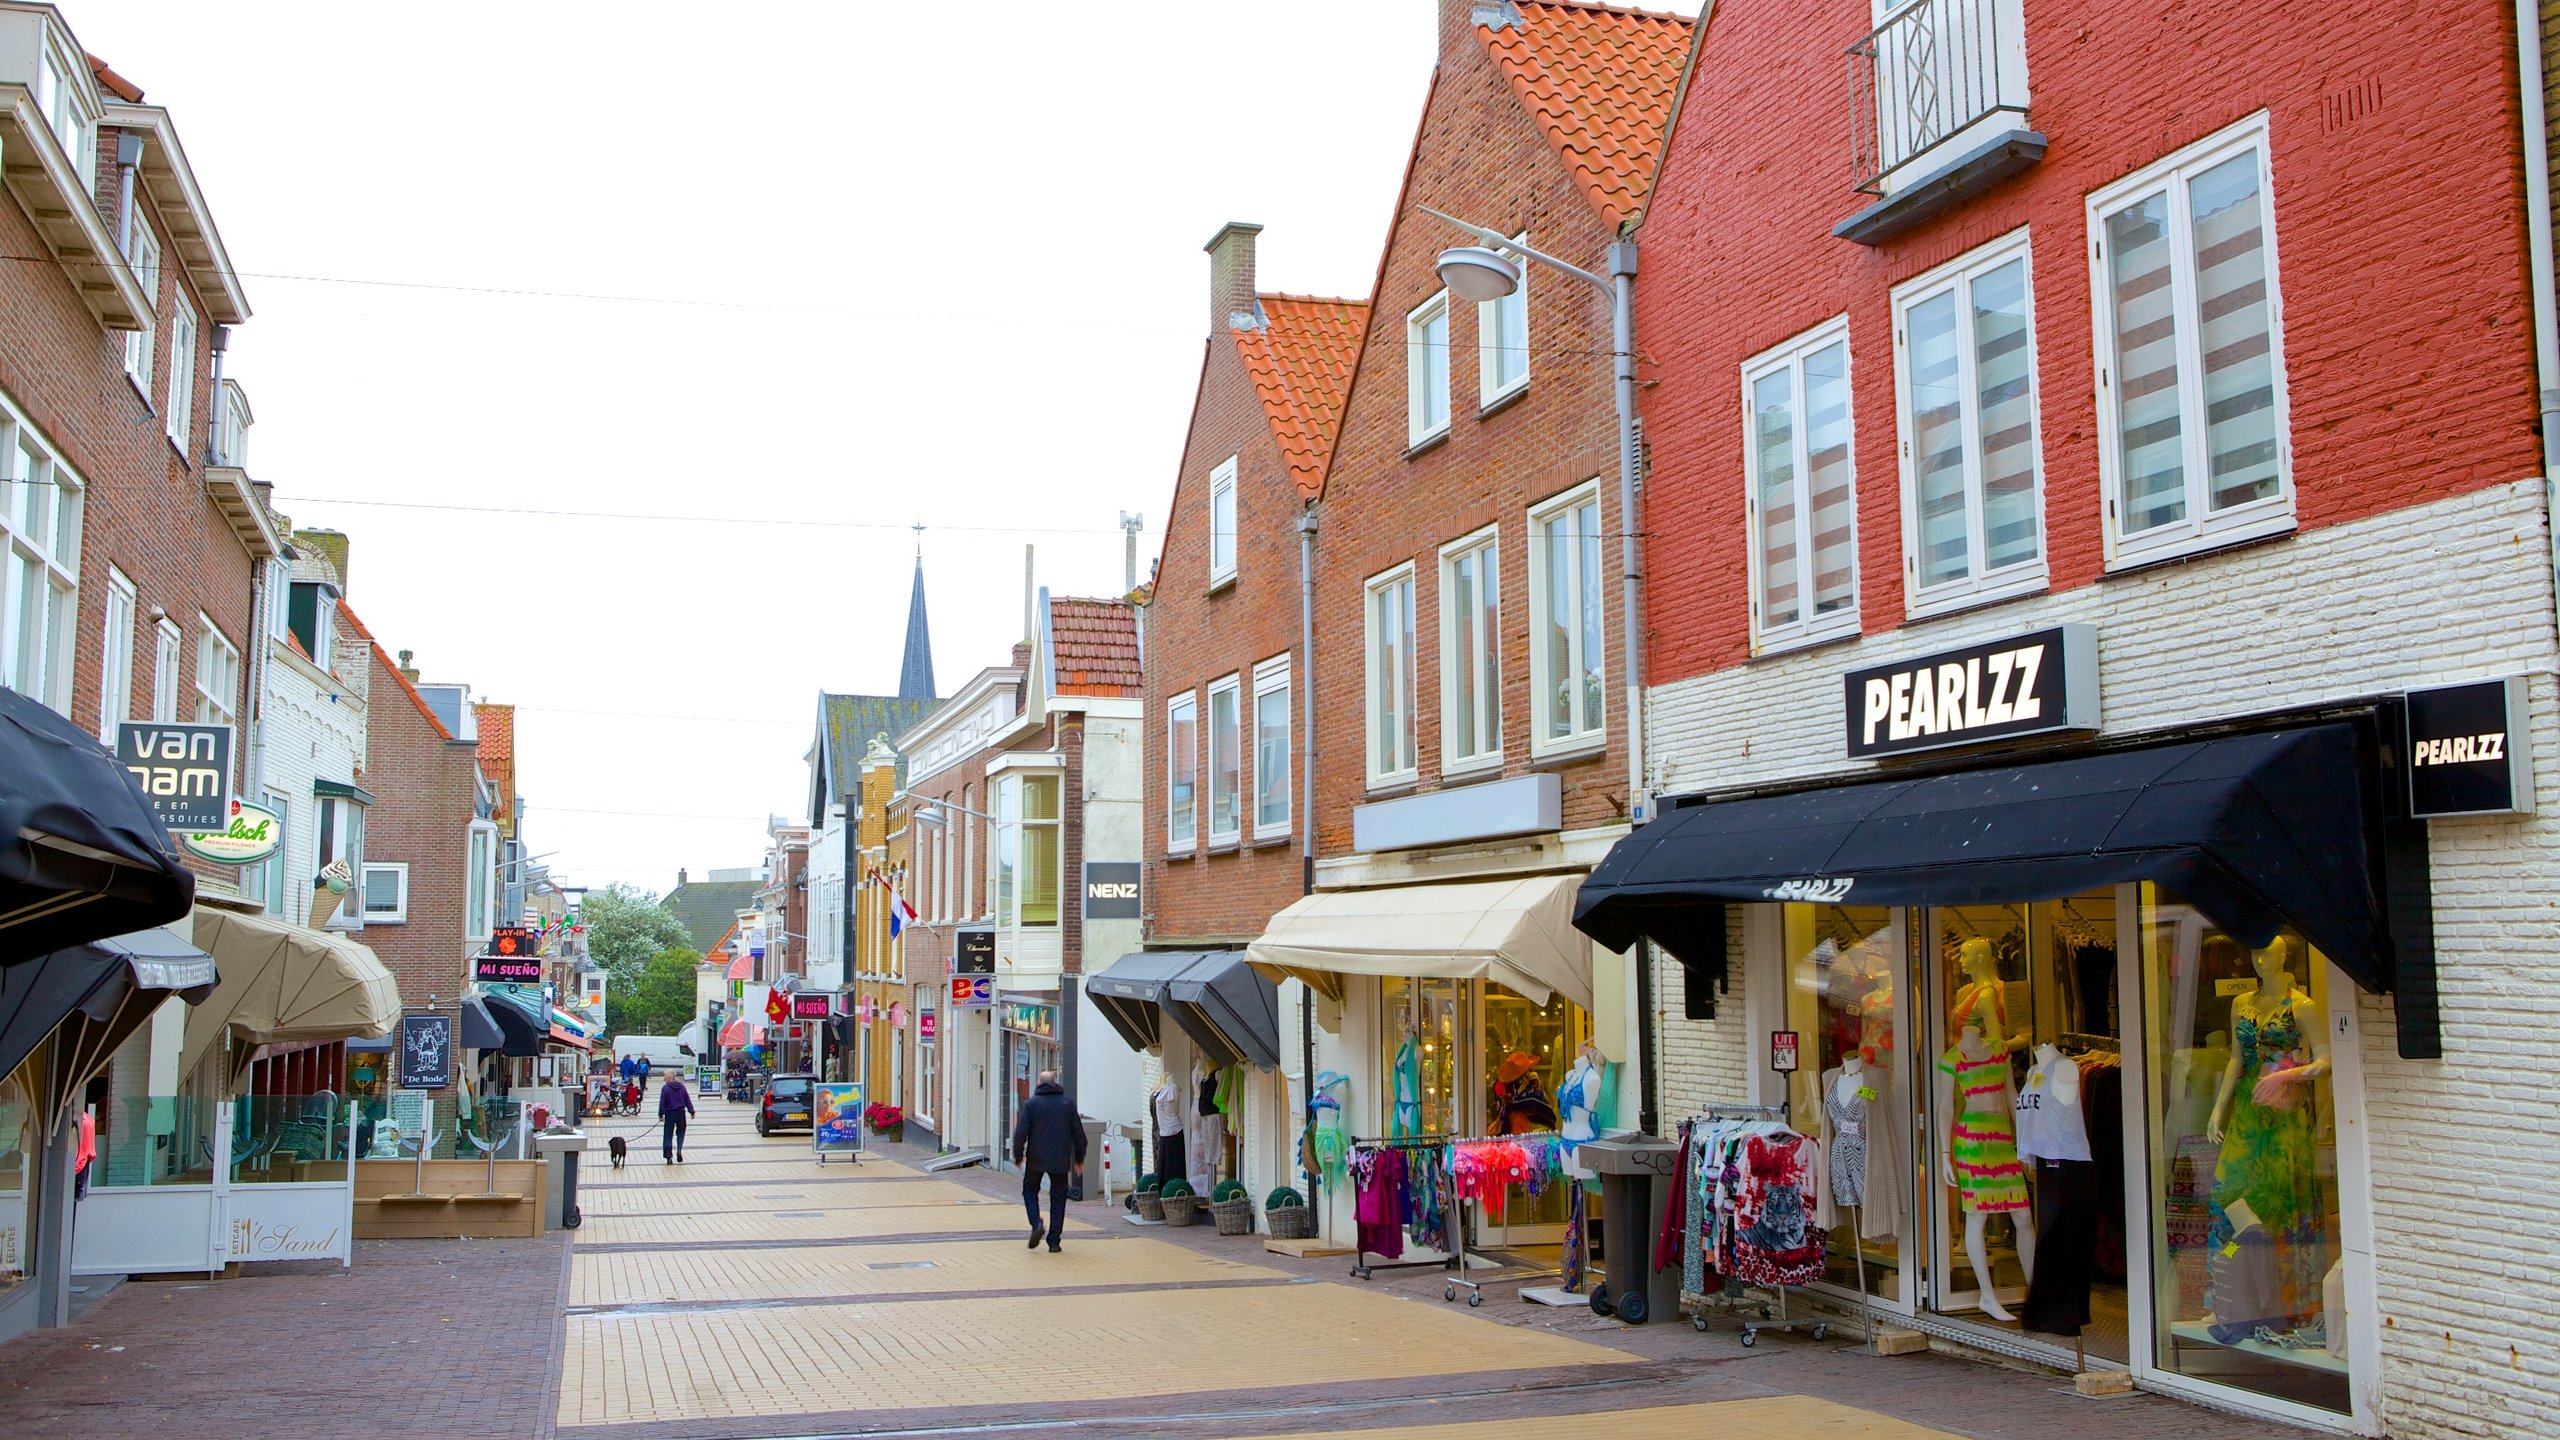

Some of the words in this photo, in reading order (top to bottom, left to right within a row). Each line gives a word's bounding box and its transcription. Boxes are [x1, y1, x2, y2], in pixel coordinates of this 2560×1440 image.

[1863, 644, 2045, 746] PEARLZZ
[134, 730, 216, 761] van
[2414, 732, 2506, 767] PEARLZZ
[160, 814, 217, 824] SSOIRES
[1088, 883, 1138, 899] NENZ
[479, 963, 497, 975] MI
[499, 962, 540, 977] SUEÑO
[952, 978, 990, 999] BC
[2226, 983, 2247, 991] OPEN
[796, 1001, 805, 1014] MI
[1774, 1033, 1795, 1045] UIT
[231, 1217, 241, 1255] EETCAFE
[258, 1224, 339, 1253] Sand
